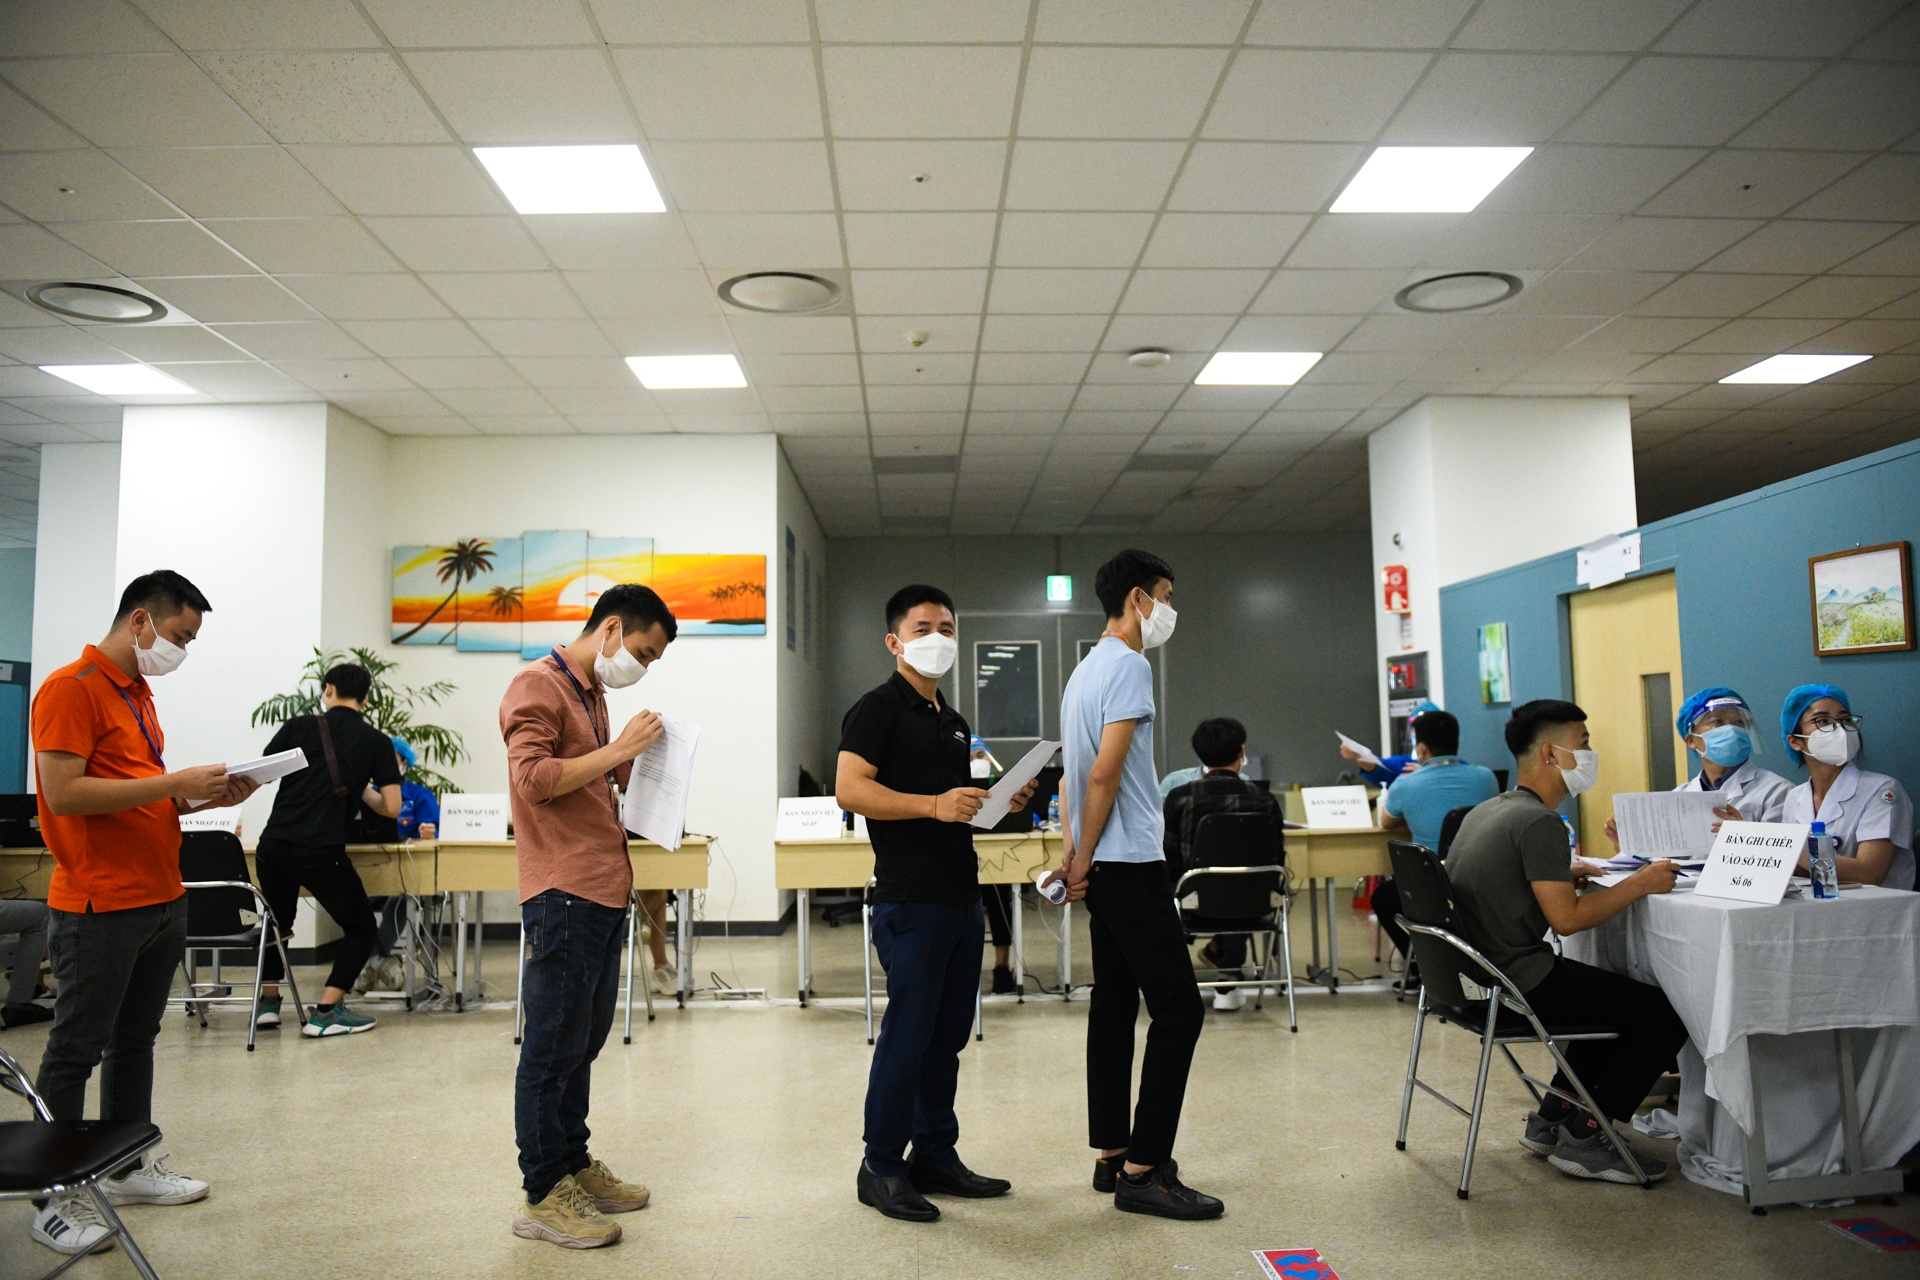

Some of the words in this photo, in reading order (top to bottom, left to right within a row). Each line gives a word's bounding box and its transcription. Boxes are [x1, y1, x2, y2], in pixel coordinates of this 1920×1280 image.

[1725, 833, 1746, 845] BÀN
[1746, 836, 1765, 846] GHI
[1721, 853, 1741, 865] VÀO
[1756, 856, 1782, 869] TIÊM
[1742, 877, 1753, 887] 06
